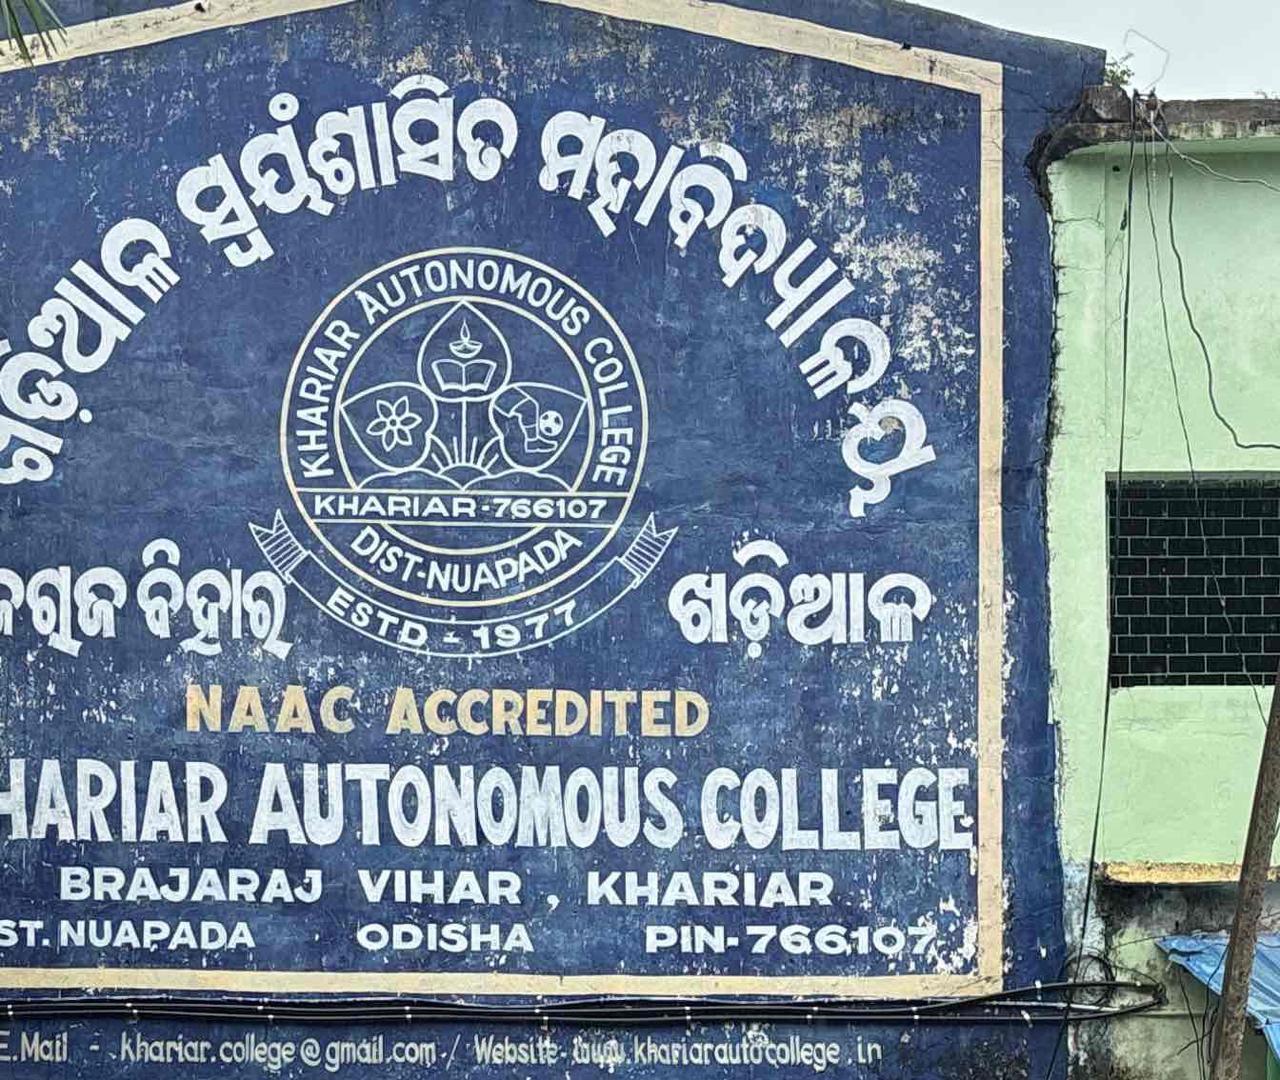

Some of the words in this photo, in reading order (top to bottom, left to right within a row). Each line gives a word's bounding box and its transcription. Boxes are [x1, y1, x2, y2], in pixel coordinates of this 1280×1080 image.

[297, 320, 360, 478] KHARIAR
[355, 259, 590, 335] AUTONOMOUS
[584, 337, 634, 486] COLLEGE
[351, 525, 582, 593] DIST-NUAPADA
[137, 539, 293, 661] ବିହାର
[327, 587, 428, 648] ESTD
[473, 600, 576, 649] 1977
[186, 684, 356, 734] NAAC
[386, 686, 709, 737] ACCREDITED
[251, 763, 681, 849] AUTONOMOUS
[701, 767, 973, 851] COLLEGE
[60, 866, 322, 903] BRAJARAJ
[587, 871, 834, 908] KHARIAR
[357, 923, 533, 952] ODISHA
